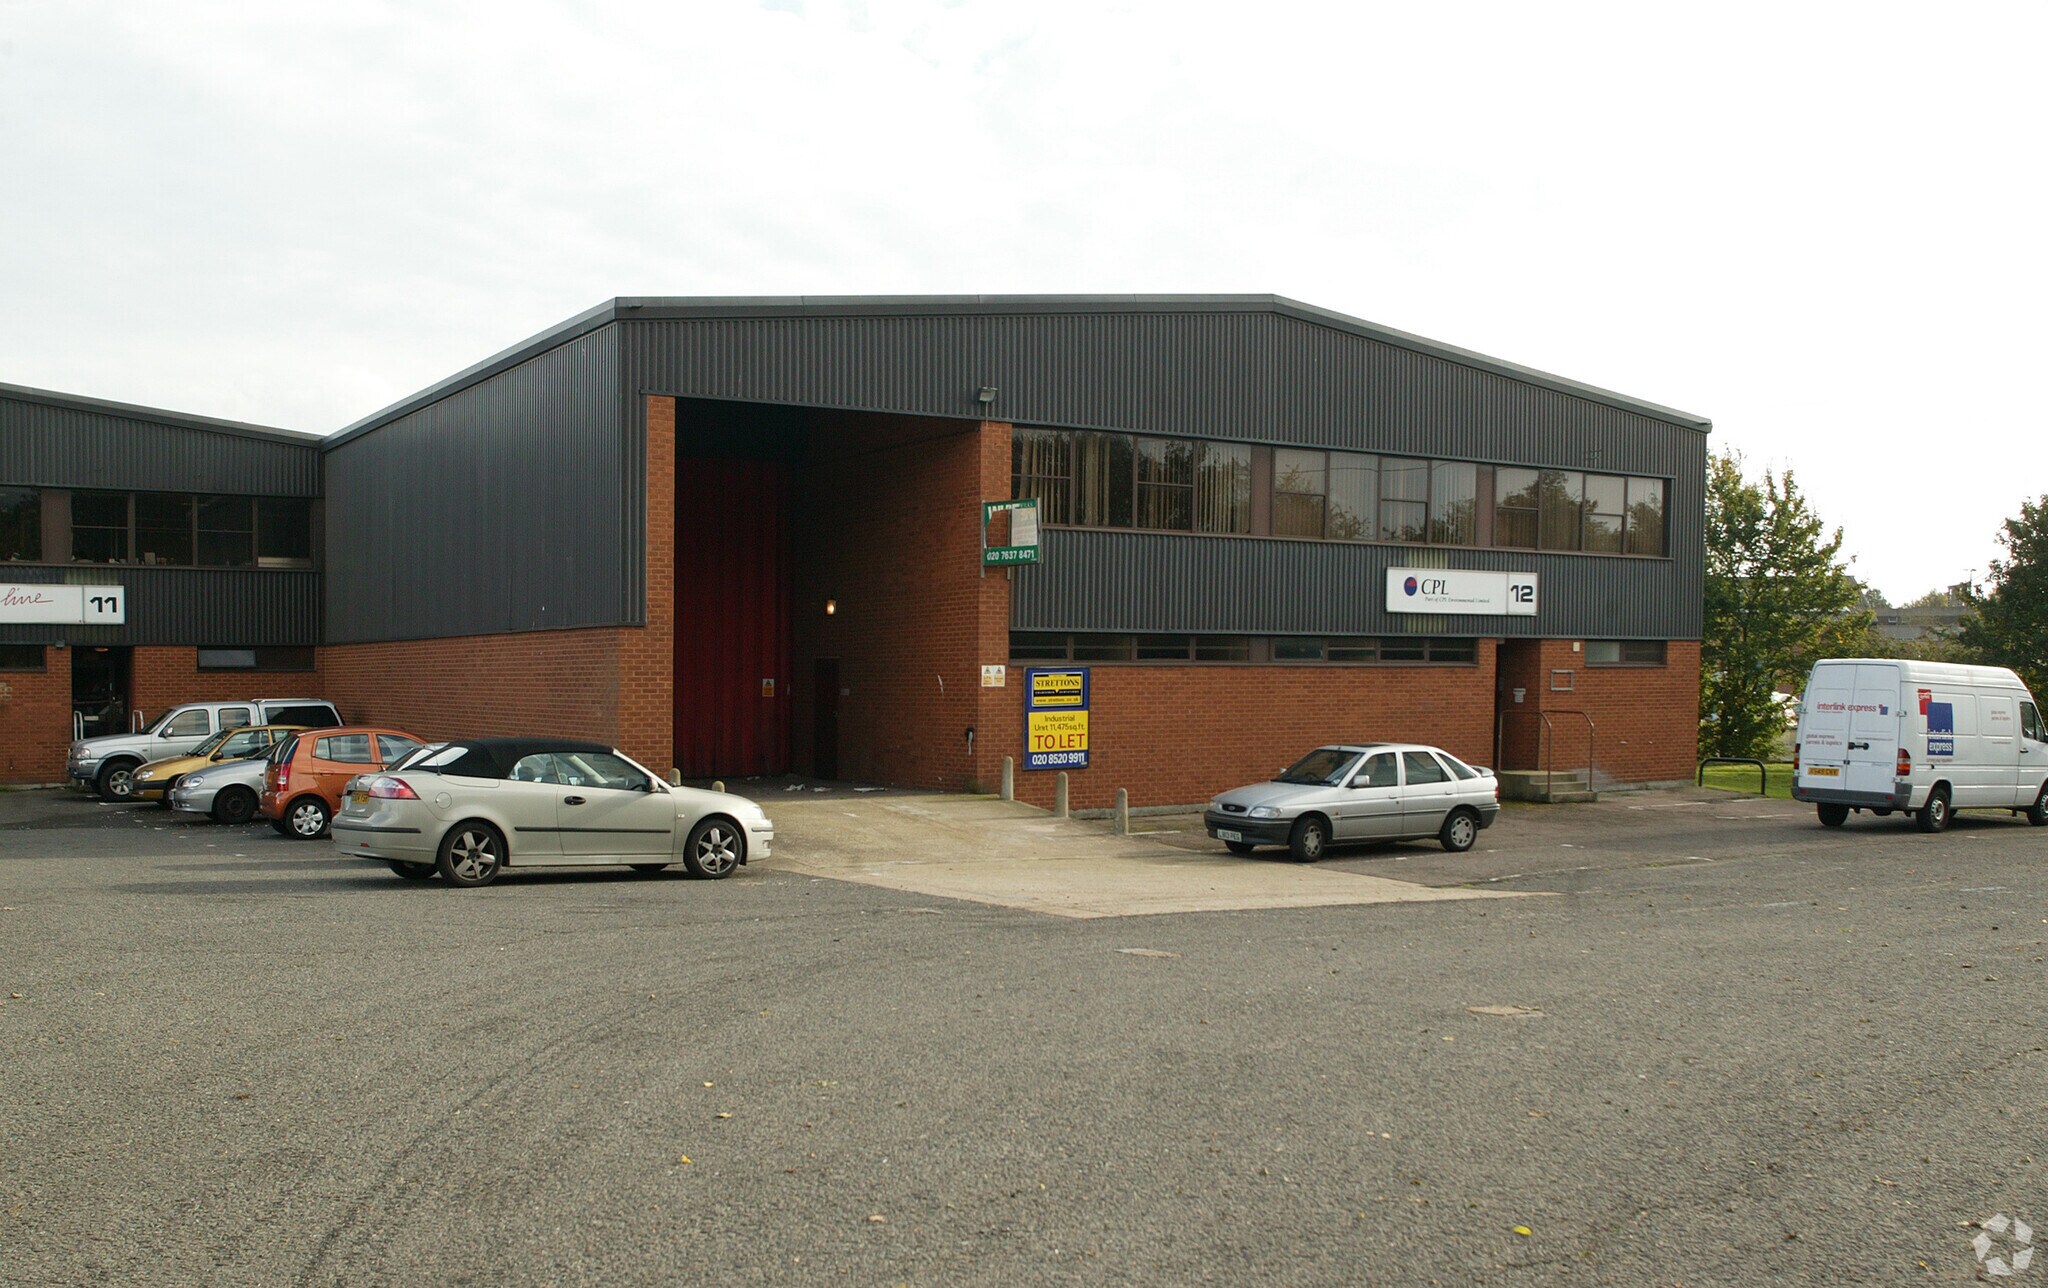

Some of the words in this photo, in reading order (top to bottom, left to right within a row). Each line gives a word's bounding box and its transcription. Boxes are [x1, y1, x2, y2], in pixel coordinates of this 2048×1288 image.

[986, 552, 1000, 561] 020
[1001, 551, 1018, 560] 7637
[1018, 550, 1035, 559] 8471
[1421, 578, 1449, 595] CPL
[1510, 584, 1534, 603] 12
[89, 596, 117, 613] 11
[1036, 679, 1080, 687] STRETTONS
[1817, 702, 1846, 711] interlink
[1847, 704, 1877, 713] express
[1034, 735, 1056, 749] TO
[1059, 733, 1086, 748] LET
[1928, 742, 1953, 753] express
[1032, 754, 1048, 765] 020
[1048, 753, 1068, 764] 8520
[1068, 752, 1085, 763] 9911
